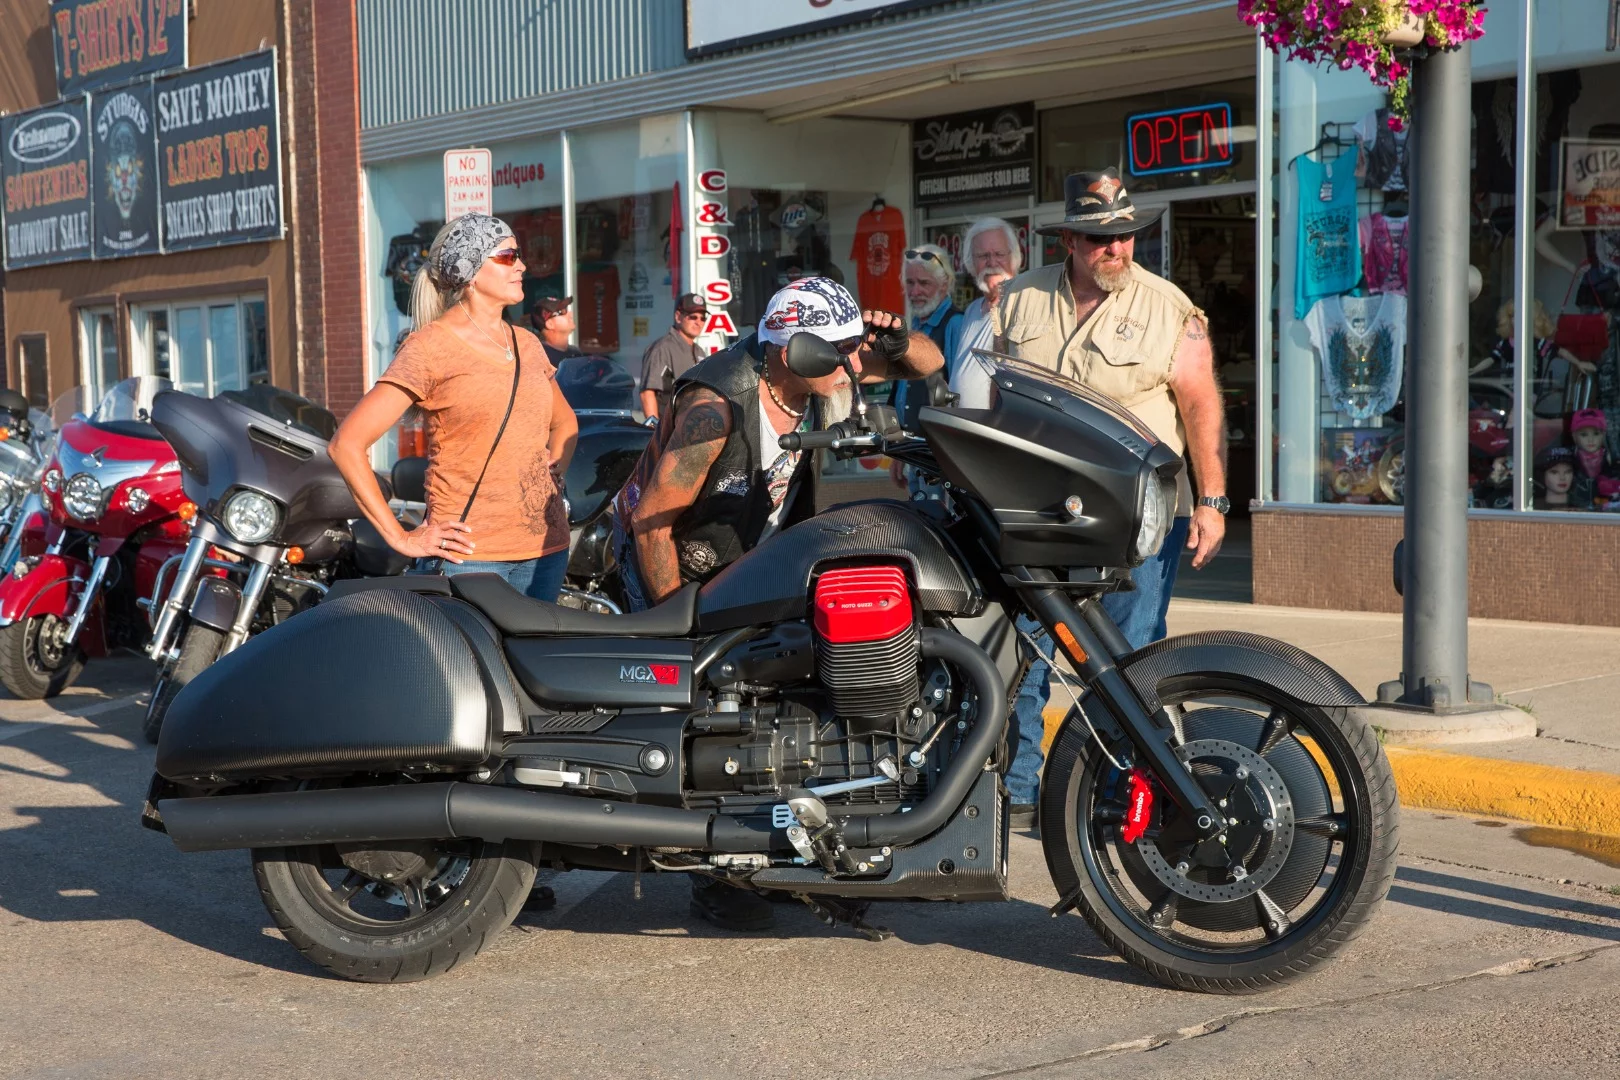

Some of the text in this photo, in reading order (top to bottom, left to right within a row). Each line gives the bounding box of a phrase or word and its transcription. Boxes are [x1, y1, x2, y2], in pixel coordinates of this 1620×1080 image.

[158, 67, 271, 132] SAVE MONEY
[166, 125, 269, 187] LADIES TOPS
[1132, 109, 1229, 169] OPEN
[5, 159, 88, 213] SOUVENIRS
[449, 174, 488, 187] PARKING
[459, 157, 476, 171] NO
[919, 178, 947, 195] OFFICIAL
[994, 169, 1011, 187] SOLD
[1012, 167, 1030, 184] HERE
[8, 216, 58, 258] BLOWOUT
[60, 211, 89, 251] SALE
[166, 184, 276, 240] DICKIES SHOP SHIRTS
[620, 665, 677, 681] MGX 21
[1132, 791, 1145, 823] brembo
